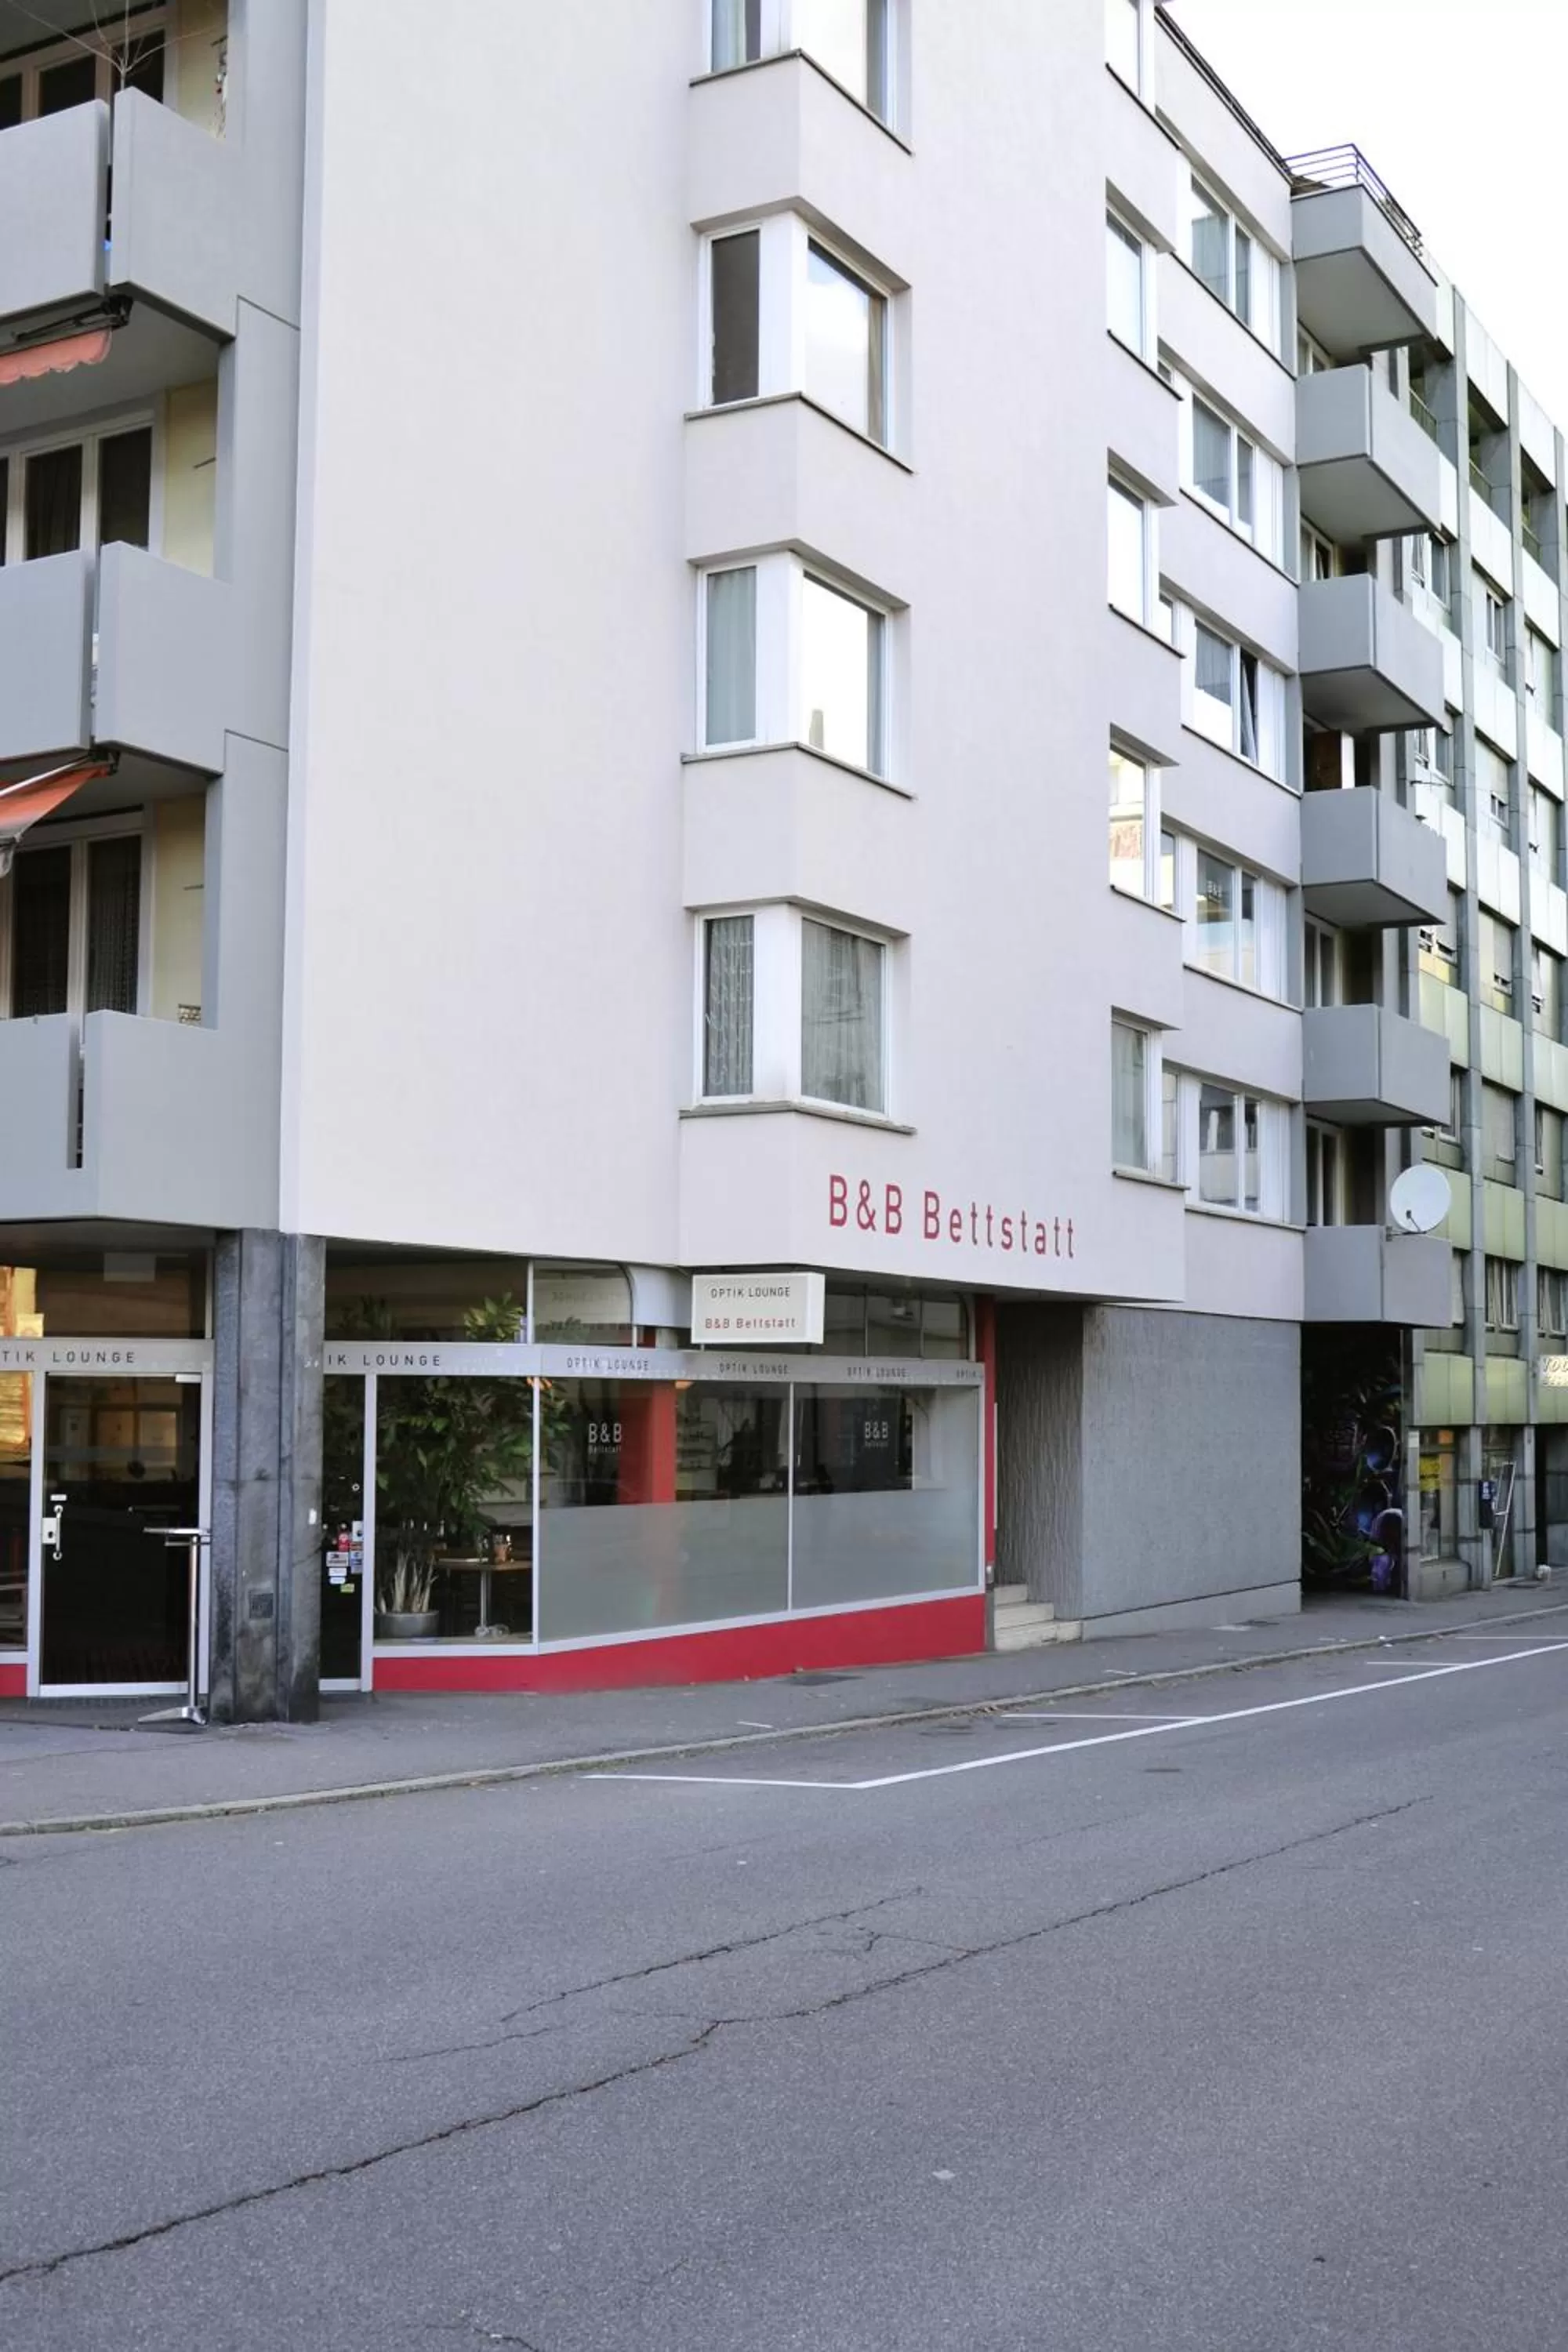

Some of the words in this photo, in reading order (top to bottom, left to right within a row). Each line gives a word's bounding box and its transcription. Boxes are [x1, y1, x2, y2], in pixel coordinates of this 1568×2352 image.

[829, 1174, 902, 1235] B&B
[924, 1190, 1074, 1258] Bettstatt
[710, 1287, 744, 1299] OPTIK
[748, 1287, 791, 1298] LOUNGE
[705, 1318, 730, 1330] B&B
[736, 1318, 796, 1329] Bettstatt
[52, 1351, 136, 1363] LOUNGE
[362, 1354, 441, 1367] LOUNGE
[566, 1356, 601, 1369] OPTIK
[608, 1358, 650, 1371] LOUNGE
[718, 1361, 747, 1374] OPTIK
[752, 1363, 789, 1374] LOUNGE
[588, 1422, 622, 1443] B&B
[864, 1420, 888, 1439] B&B
